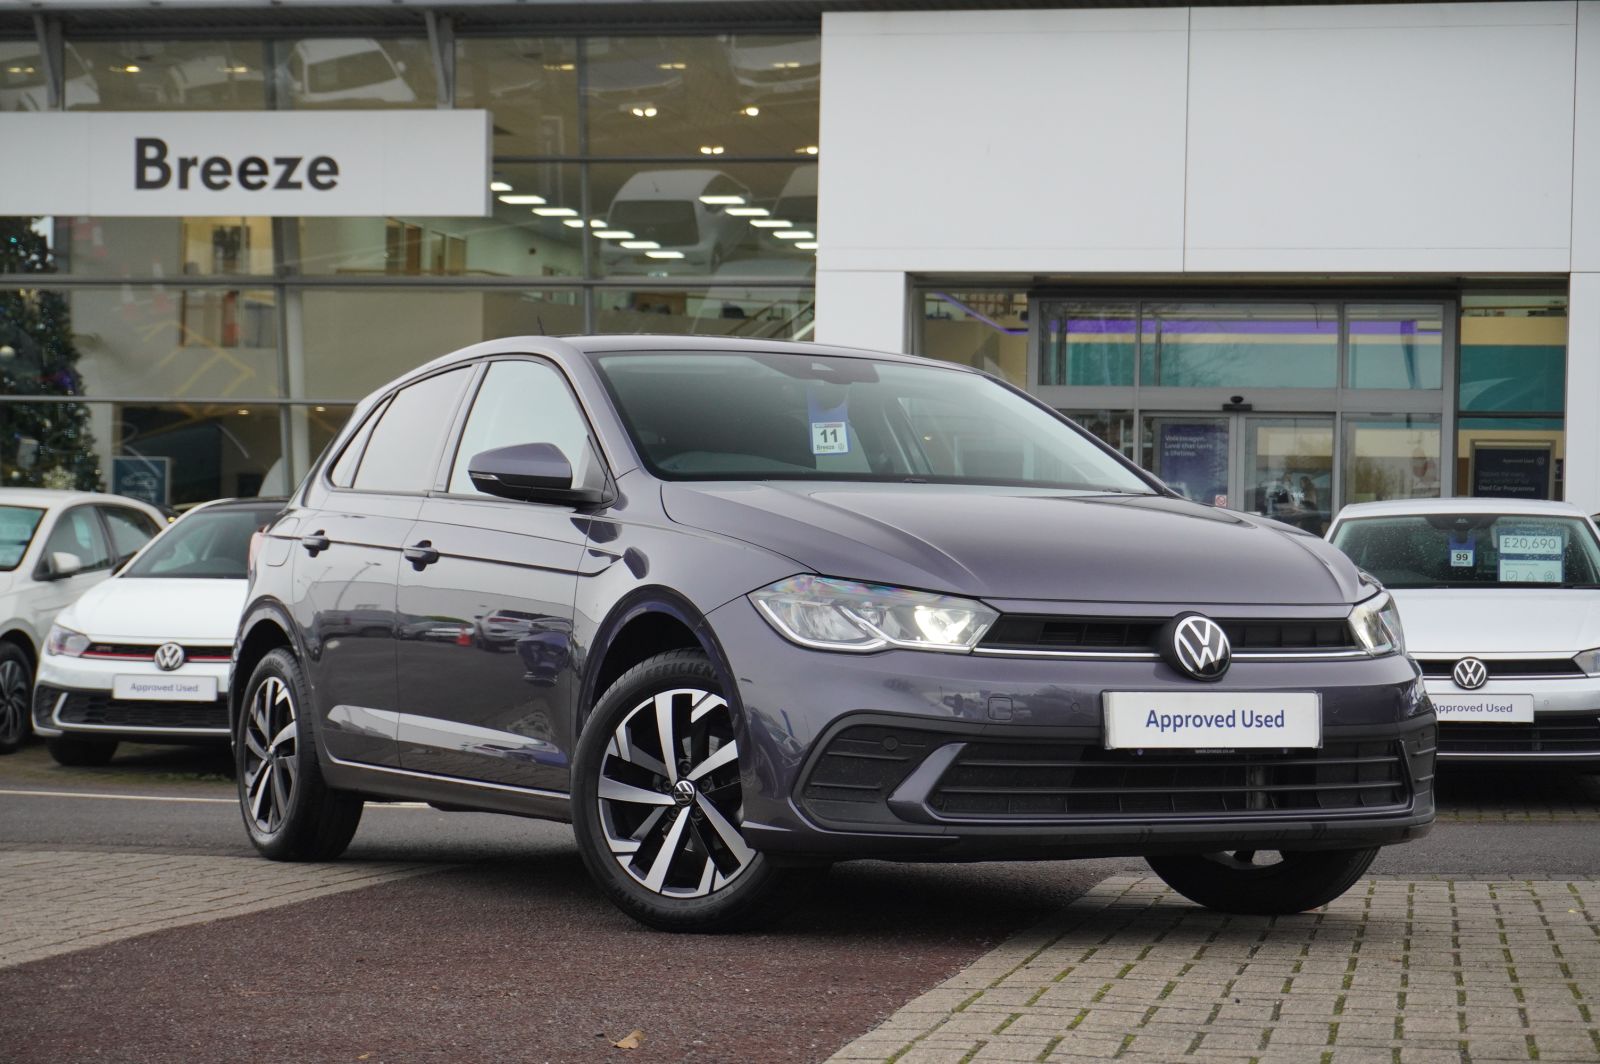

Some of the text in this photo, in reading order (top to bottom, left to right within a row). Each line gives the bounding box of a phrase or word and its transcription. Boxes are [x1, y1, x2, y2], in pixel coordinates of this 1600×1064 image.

[134, 137, 340, 191] Breeze
[820, 428, 838, 443] 11
[1503, 537, 1557, 550] £20,690
[1456, 552, 1469, 561] 99
[130, 682, 199, 693] Approved Used
[1486, 703, 1513, 713] Used
[1146, 709, 1285, 732] Approved Used
